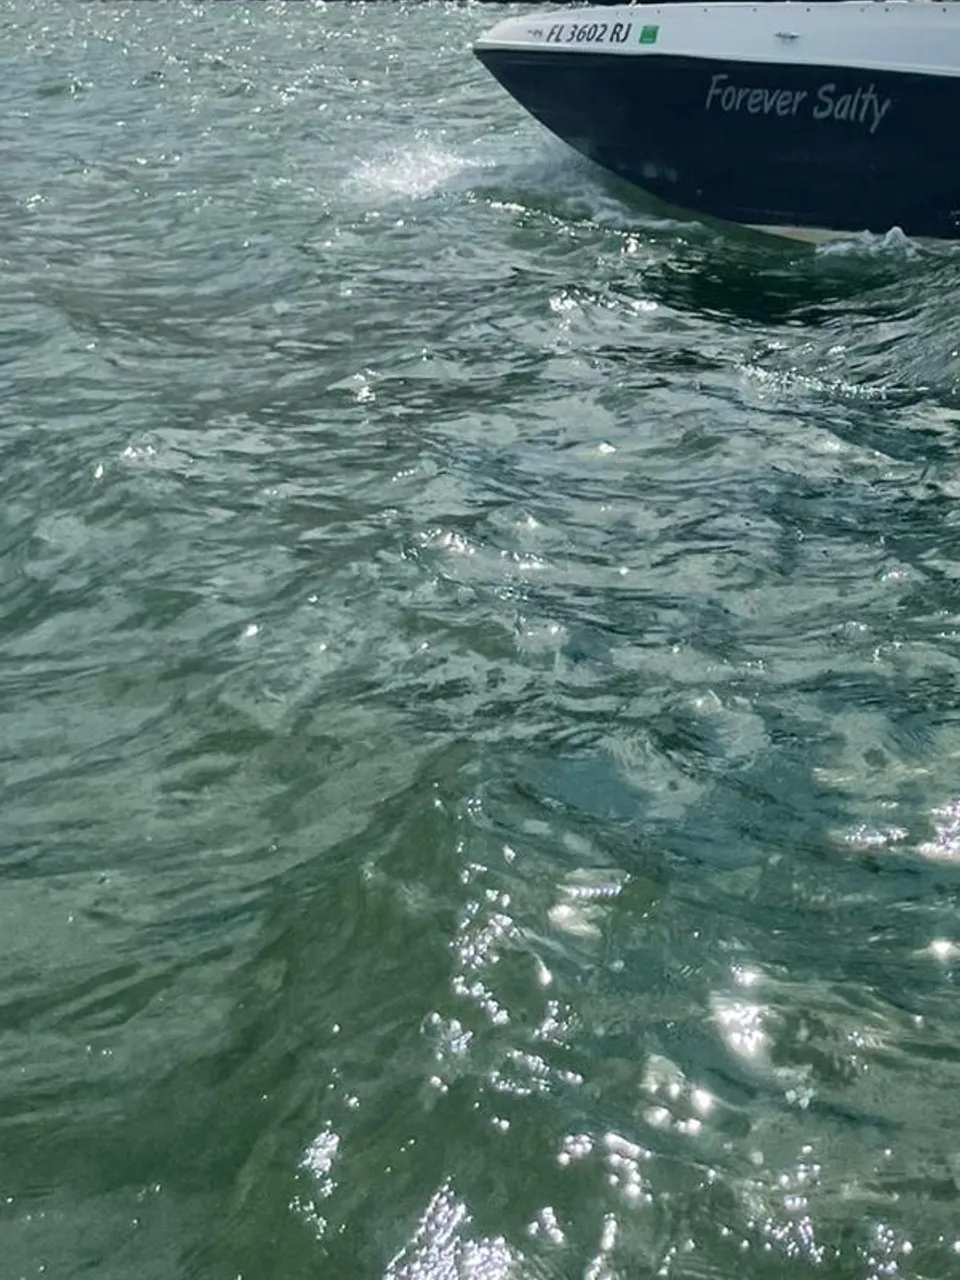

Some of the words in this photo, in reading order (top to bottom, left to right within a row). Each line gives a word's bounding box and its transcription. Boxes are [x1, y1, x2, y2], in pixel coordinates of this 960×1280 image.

[546, 24, 564, 42] FL
[565, 24, 608, 43] 3602
[610, 22, 632, 42] RJ
[705, 73, 807, 117] Forever
[812, 81, 891, 134] Salty
